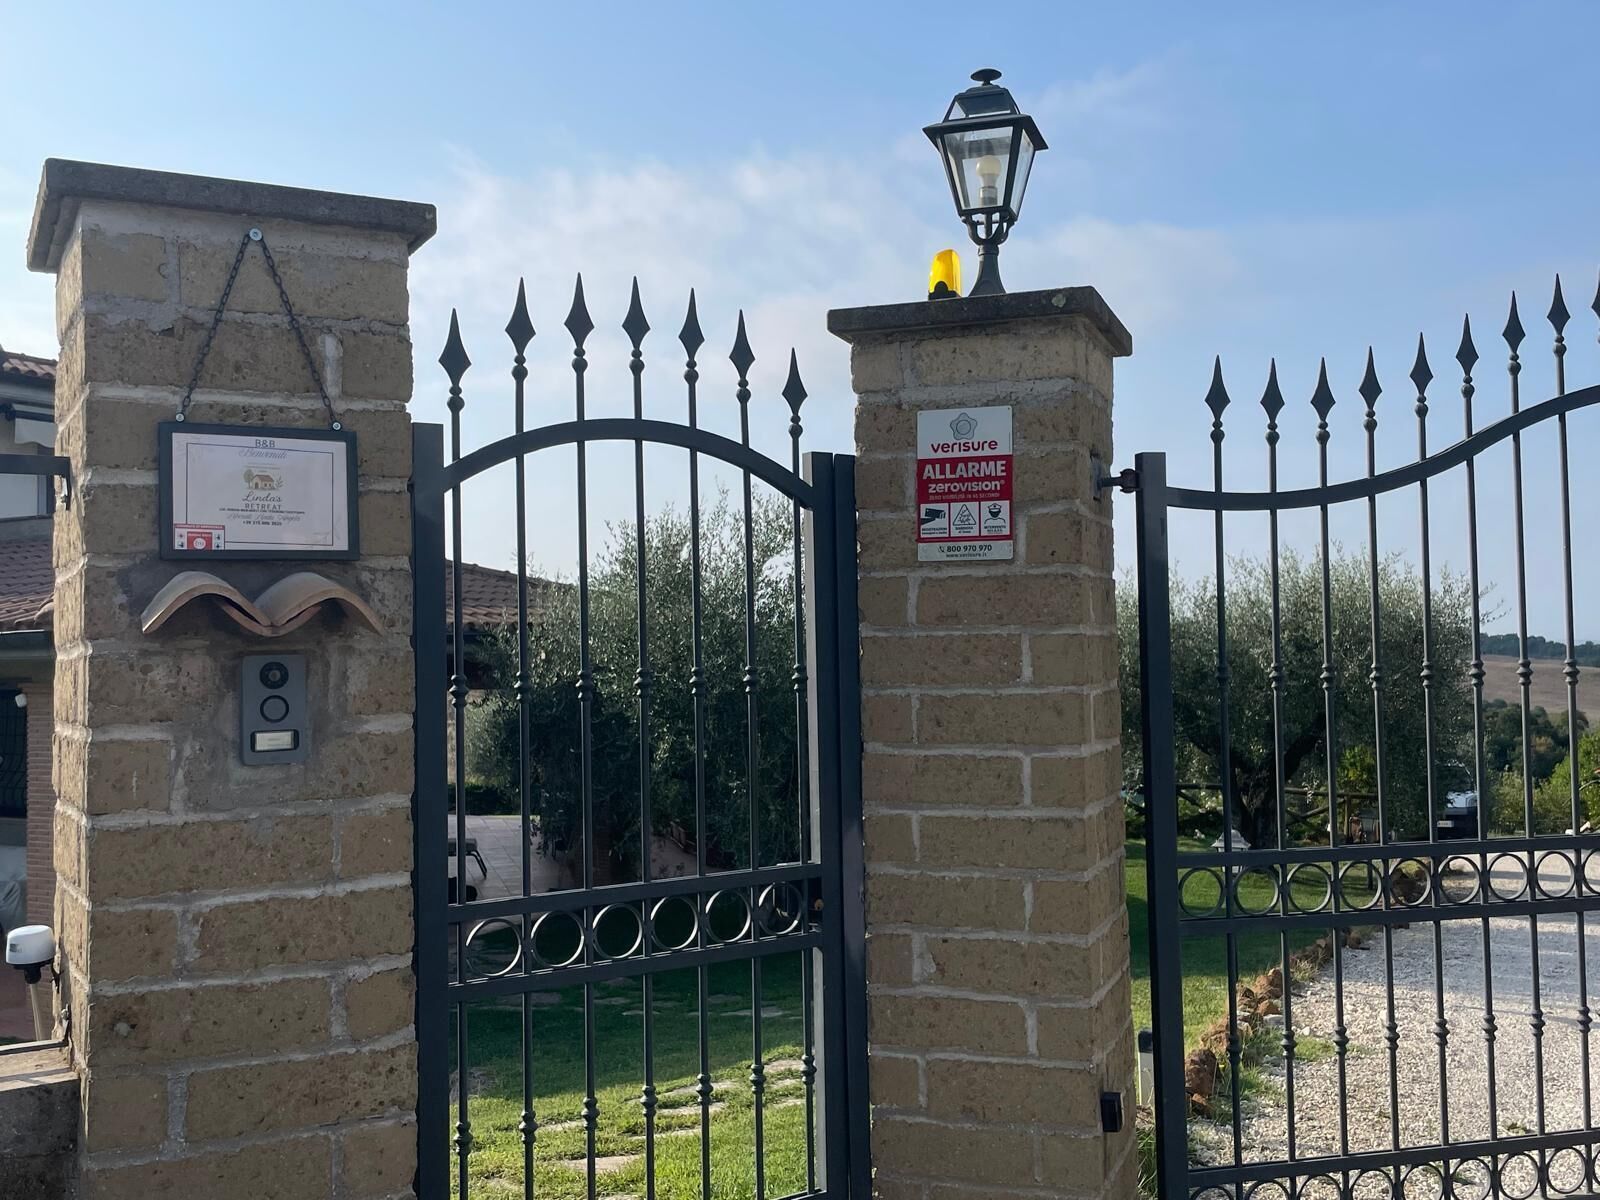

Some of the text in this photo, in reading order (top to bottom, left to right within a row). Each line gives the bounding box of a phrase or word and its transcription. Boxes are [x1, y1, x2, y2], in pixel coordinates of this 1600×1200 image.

[255, 439, 276, 448] B&B
[931, 440, 998, 453] verisure
[922, 460, 1007, 480] ALLARME
[242, 491, 282, 502] Linda's
[244, 503, 282, 511] RETREAT
[946, 544, 993, 553] 800 970 970
